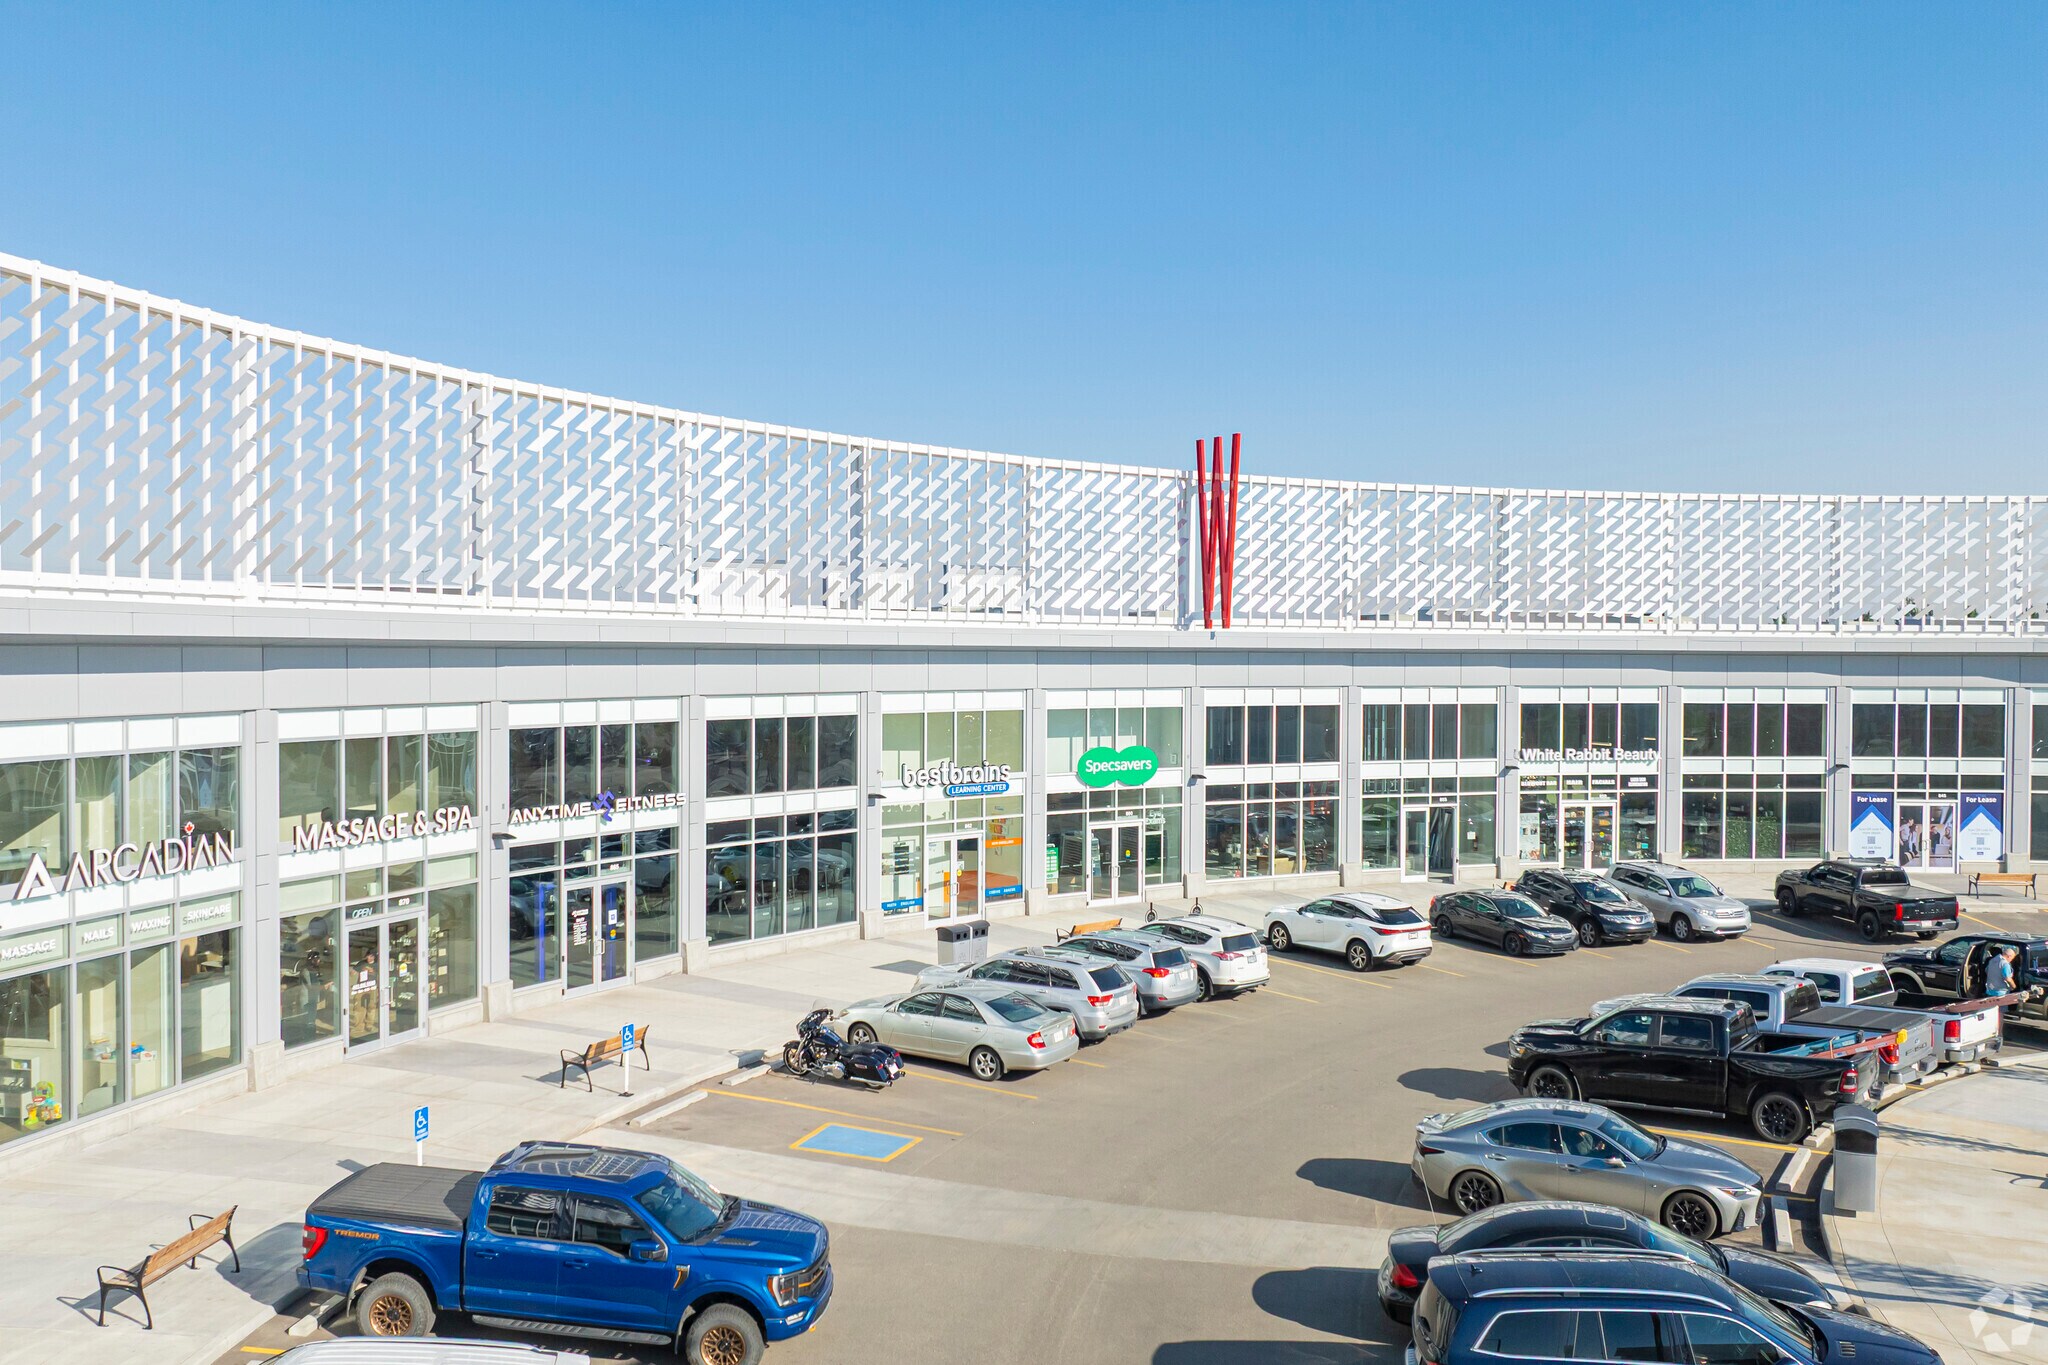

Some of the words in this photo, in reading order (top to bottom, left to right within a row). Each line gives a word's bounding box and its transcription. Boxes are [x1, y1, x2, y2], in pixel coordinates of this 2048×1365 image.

[1521, 748, 1561, 761] White
[1565, 748, 1611, 761] Rabbit
[1615, 748, 1661, 763] Beauty
[1085, 759, 1152, 774] Specsavers
[951, 785, 982, 794] LEARNING
[983, 783, 1007, 792] CENTER
[509, 801, 592, 824] ANYTIME
[615, 793, 687, 812] FITNESS
[293, 812, 409, 852] MASSAGE
[412, 810, 429, 836] &
[433, 804, 474, 834] SPA
[62, 822, 235, 893] ARCADIAN
[187, 903, 232, 921] SKINCARE
[352, 907, 373, 919] OPEN
[131, 915, 171, 933] WAXING
[83, 926, 115, 943] NAILS
[1, 938, 57, 961] MASSAGE
[334, 1229, 380, 1240] TREMOR
